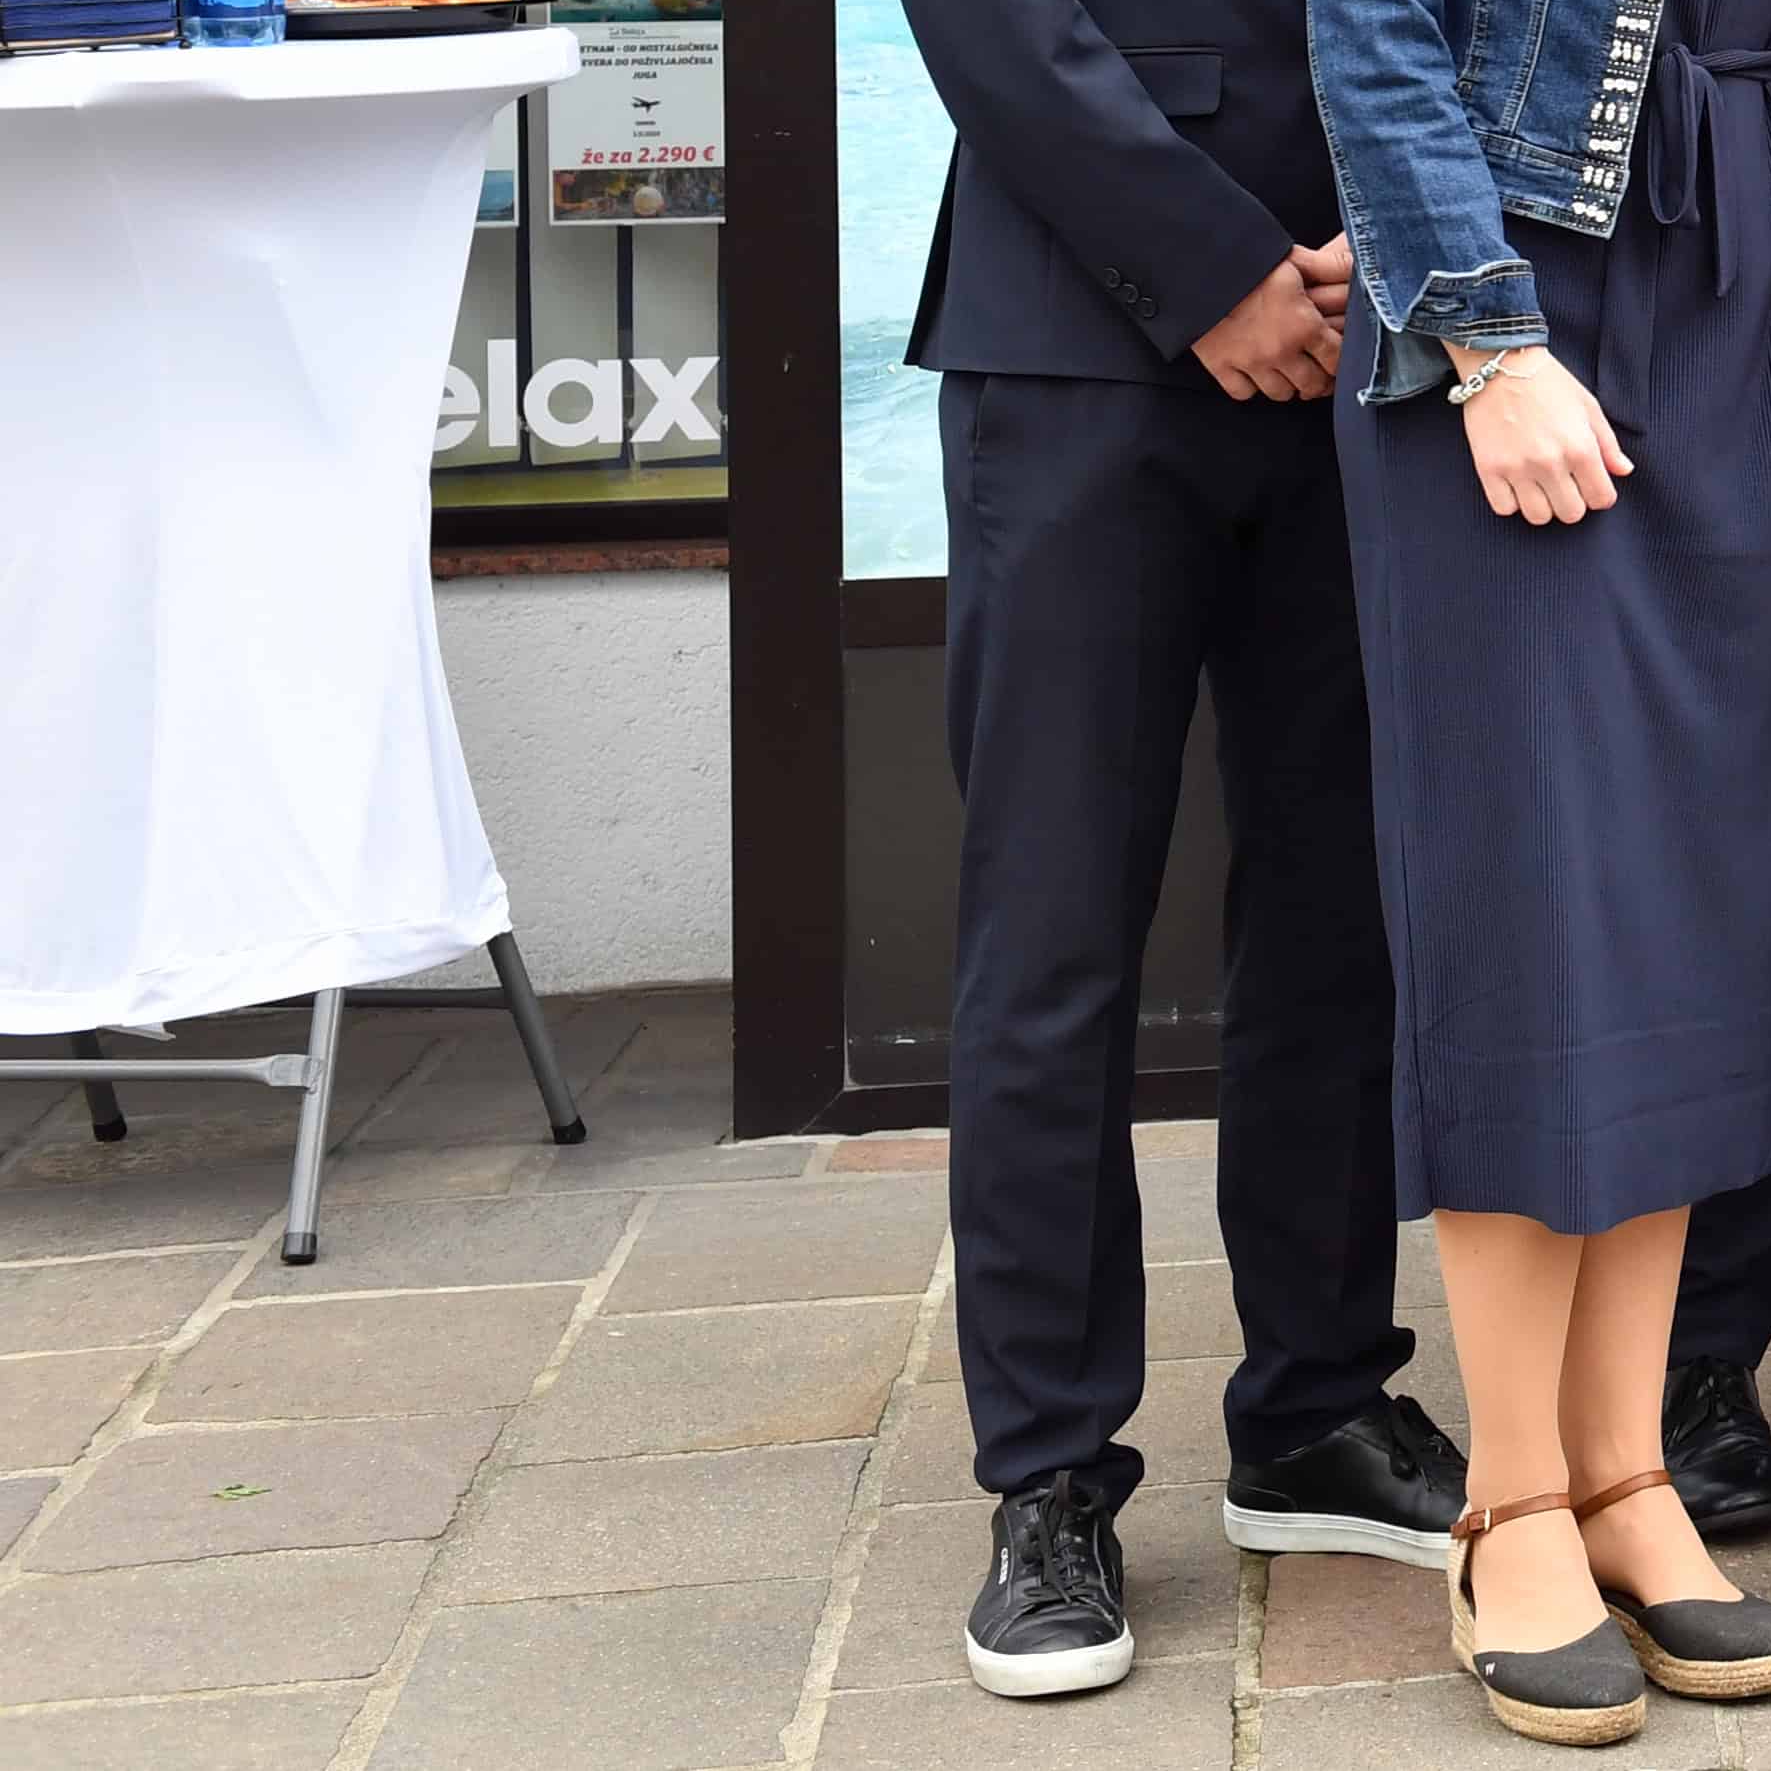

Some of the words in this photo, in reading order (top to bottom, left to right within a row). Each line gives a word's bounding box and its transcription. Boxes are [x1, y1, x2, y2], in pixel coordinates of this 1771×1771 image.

[582, 148, 604, 164] že
[609, 150, 632, 164] za
[637, 146, 697, 164] 2.290
[702, 146, 716, 162] €
